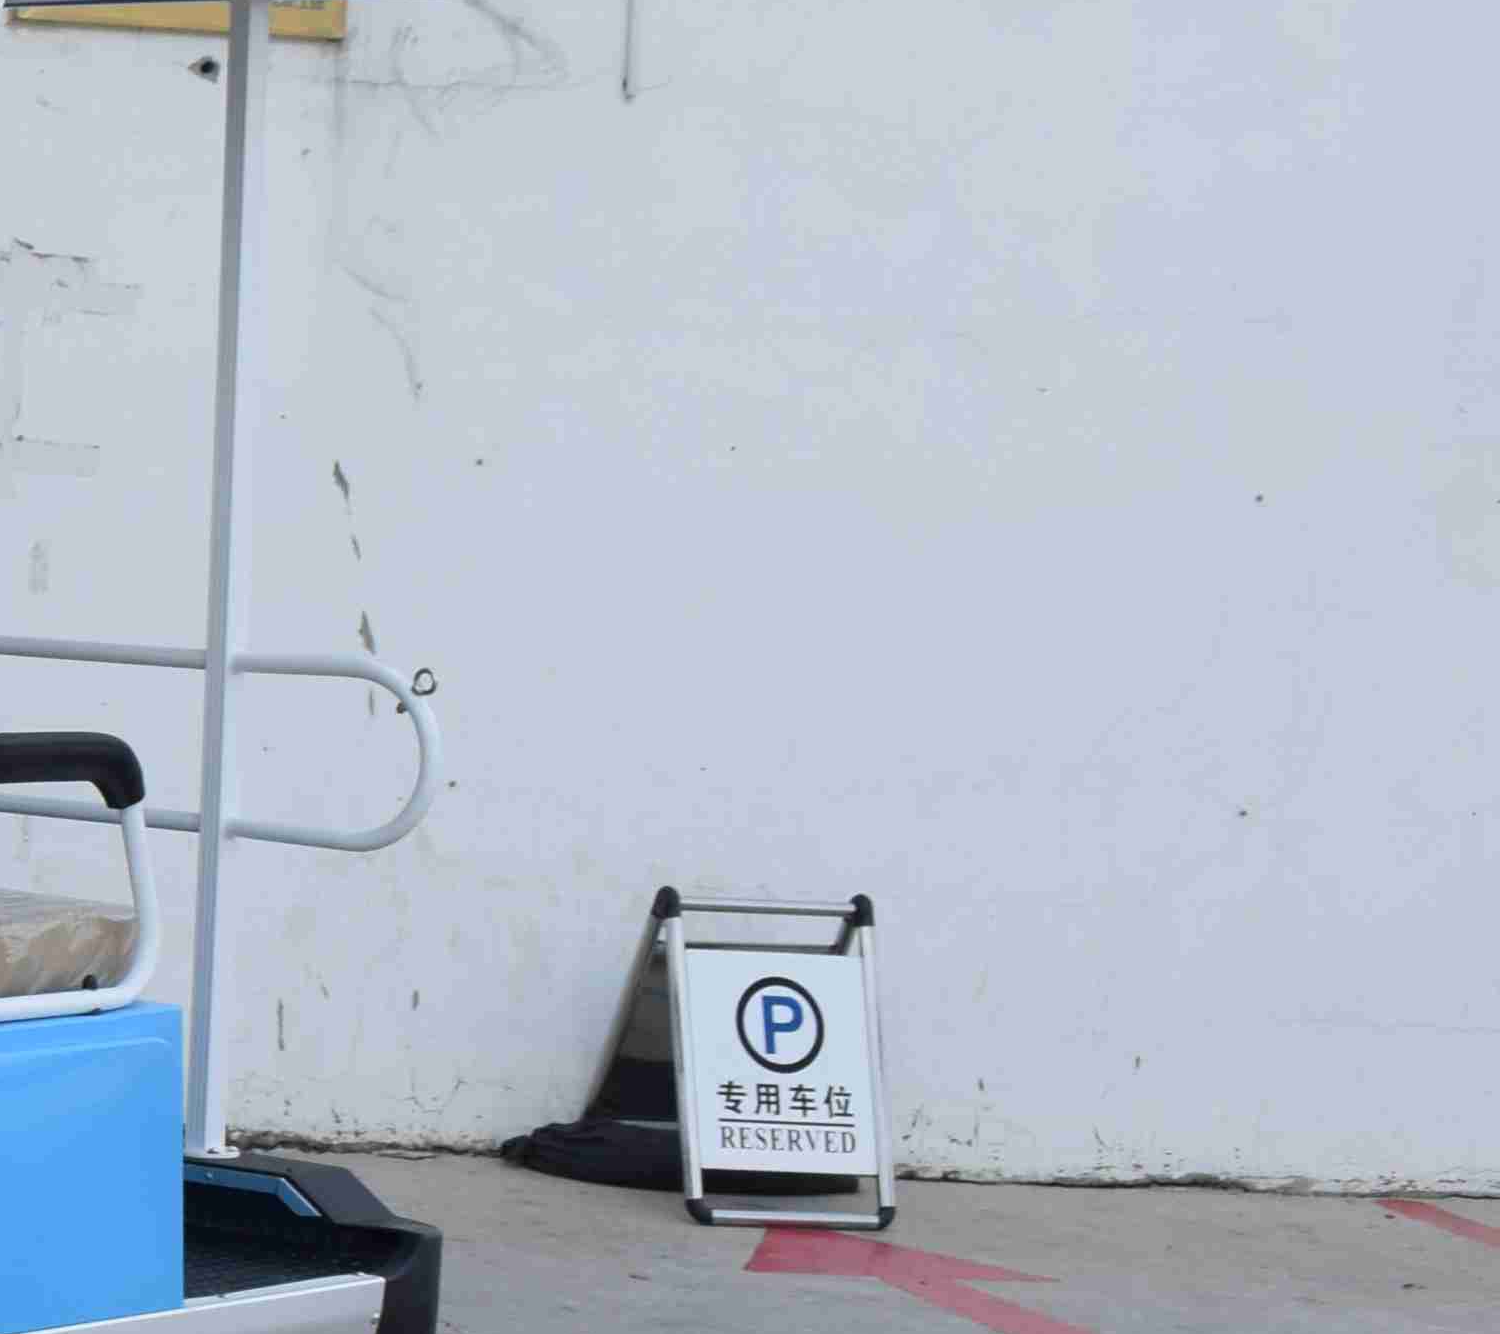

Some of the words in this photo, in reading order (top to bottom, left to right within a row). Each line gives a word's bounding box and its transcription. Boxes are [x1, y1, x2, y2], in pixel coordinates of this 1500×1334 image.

[762, 995, 803, 1054] P
[717, 1079, 854, 1118] 专用车位
[719, 1125, 857, 1155] RESERVED
